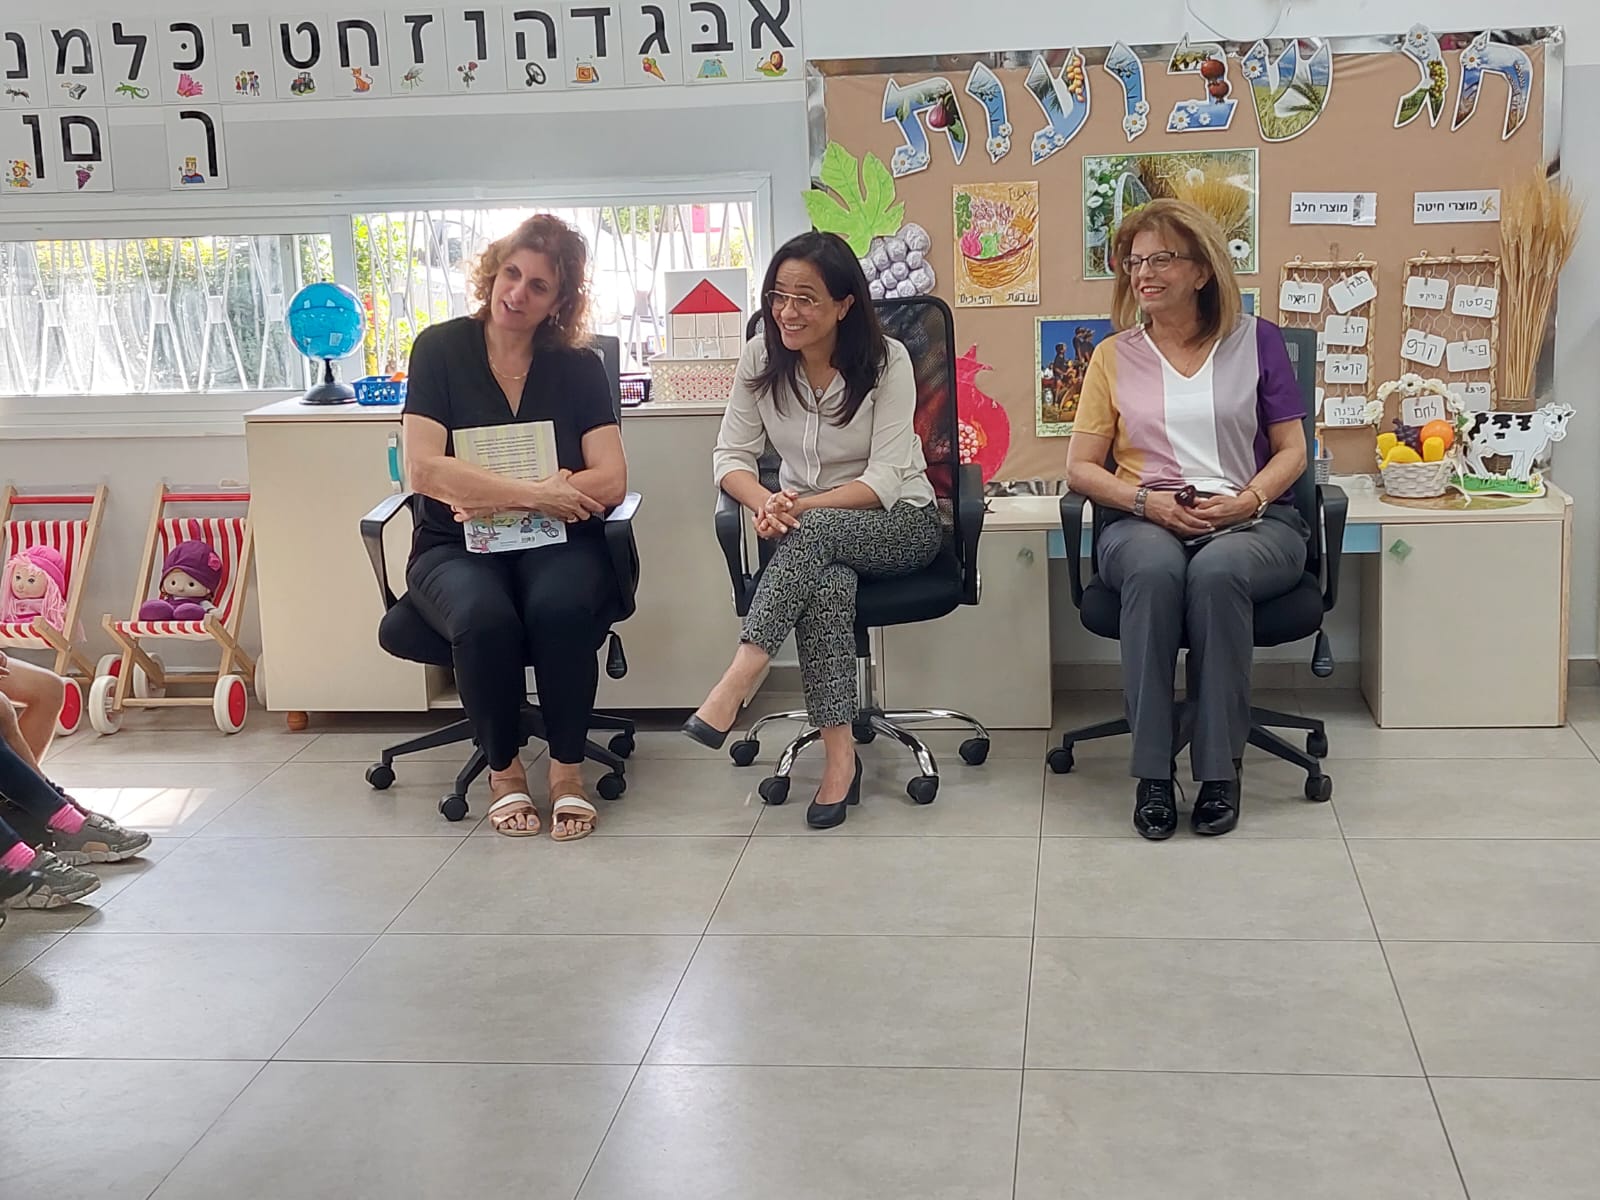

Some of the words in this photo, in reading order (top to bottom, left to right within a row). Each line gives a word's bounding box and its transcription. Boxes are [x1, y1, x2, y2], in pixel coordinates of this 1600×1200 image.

[231, 23, 251, 47] י
[280, 21, 321, 70] ט
[337, 19, 380, 68] ח
[404, 14, 433, 64] ז
[463, 10, 487, 61] ו
[514, 10, 557, 60] ה
[570, 7, 611, 58] ד
[638, 5, 670, 55] ג
[749, 0, 793, 49] א
[4, 31, 29, 80] נ
[51, 28, 94, 75] מ
[112, 22, 147, 81] ל
[881, 32, 1332, 177] שבועות
[1393, 23, 1532, 140] חג
[22, 114, 45, 179] ן
[59, 115, 102, 162] ם
[1294, 201, 1316, 213] חלב
[1319, 202, 1348, 213] מוצרי
[1416, 202, 1445, 213] חיטה
[1448, 201, 1478, 212] מוצרי
[1459, 297, 1493, 311] פסטה
[1343, 324, 1364, 334] חלב
[1413, 401, 1437, 419] לחם
